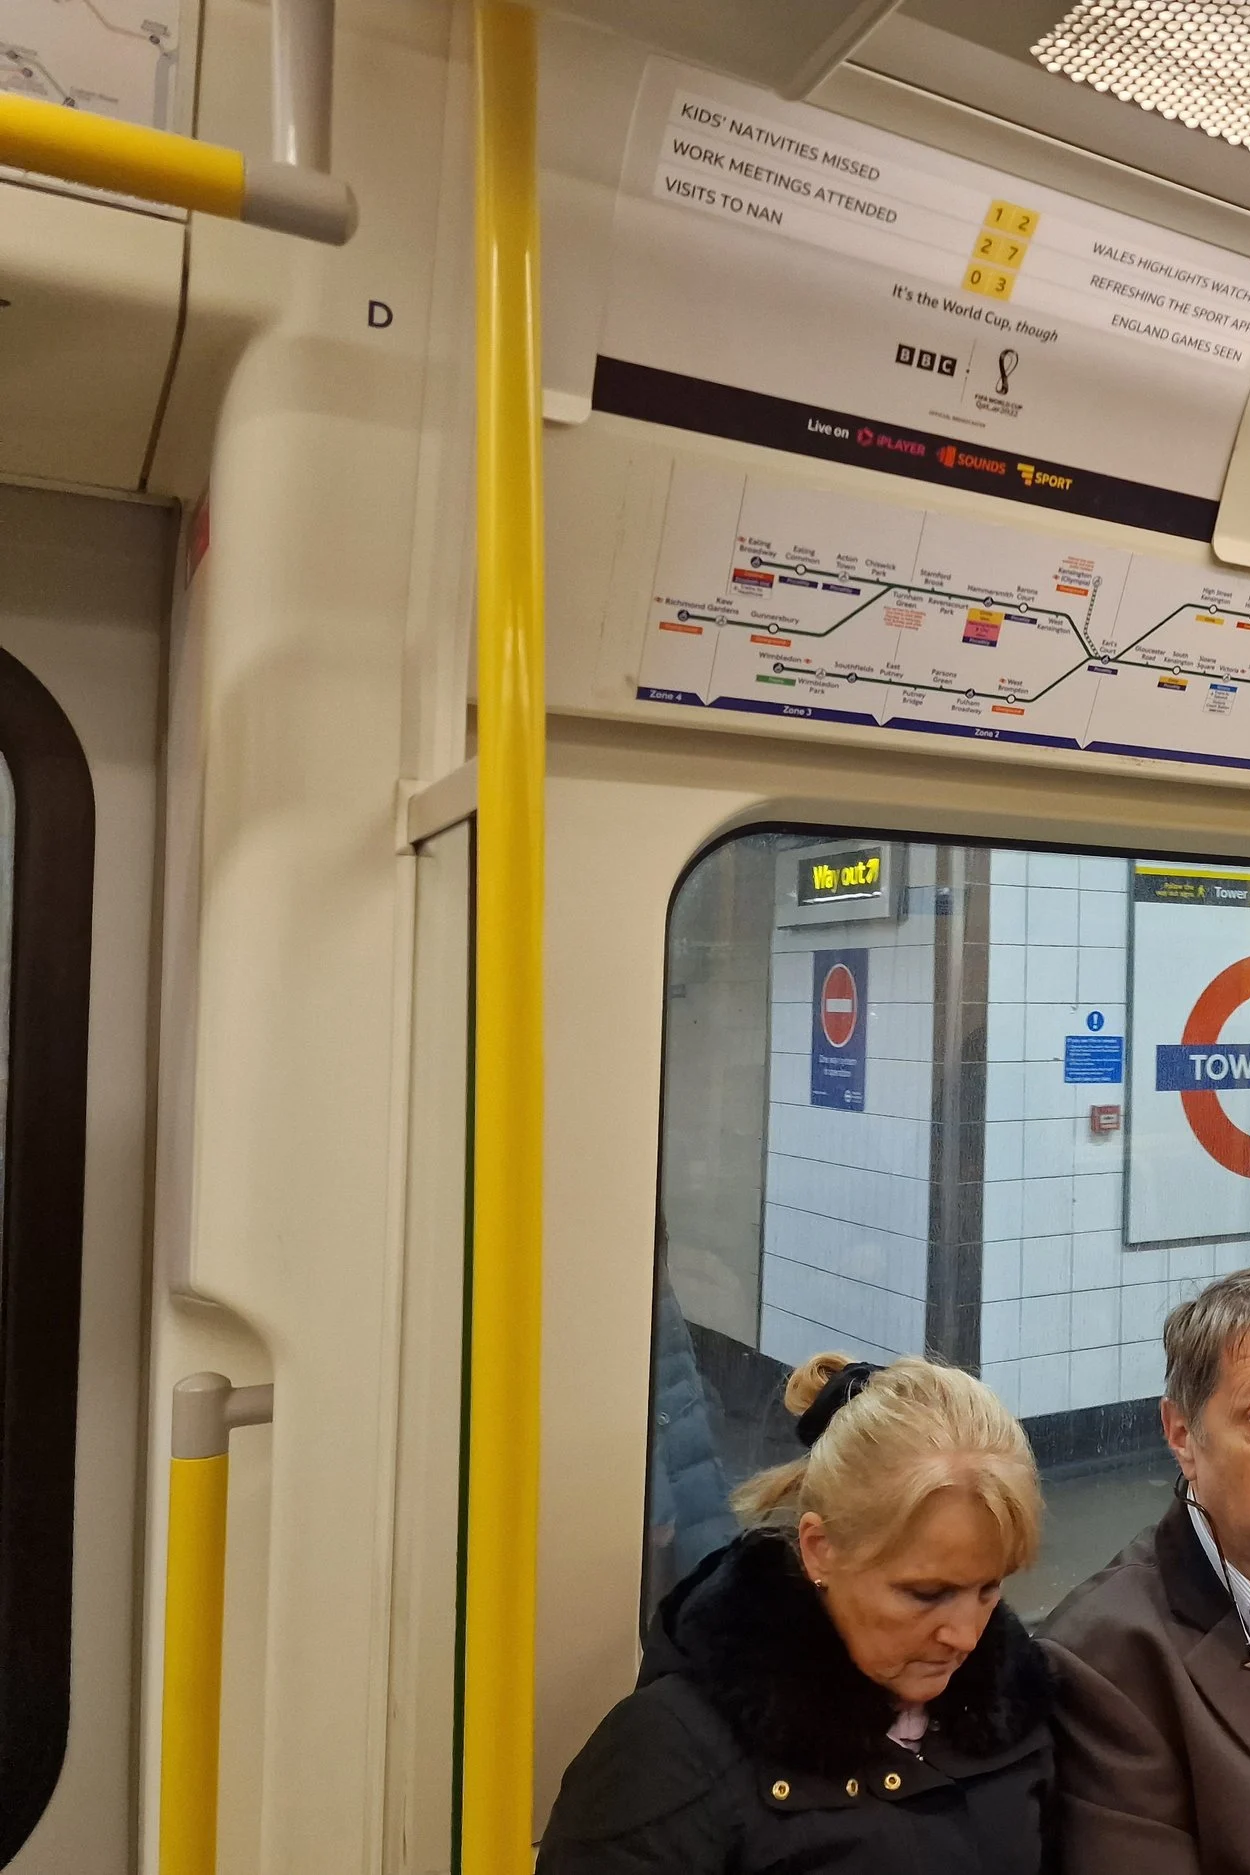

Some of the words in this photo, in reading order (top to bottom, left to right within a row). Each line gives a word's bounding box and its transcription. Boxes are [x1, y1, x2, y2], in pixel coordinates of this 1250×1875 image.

[681, 102, 727, 128] KIDS'
[729, 119, 818, 161] NATIVITIES
[822, 151, 880, 181] MISSED
[995, 208, 1003, 222] 1
[1018, 216, 1030, 232] 2
[1093, 242, 1135, 265] WALES
[1137, 257, 1209, 288] HIGHLIGHTS
[673, 139, 725, 168] WORK
[729, 158, 812, 196] MEETINGS
[814, 187, 898, 224] ATTENDED
[980, 238, 992, 254] 2
[1008, 247, 1019, 261] 7
[1090, 274, 1165, 308] REFRESHING
[1168, 298, 1191, 315] THE
[1193, 306, 1231, 326] SPORT
[665, 176, 716, 204] VISITS
[720, 193, 743, 213] TO
[747, 203, 783, 225] NAN
[971, 270, 982, 285] 0
[995, 277, 1006, 292] 3
[1111, 314, 1169, 340] ENGLAND
[1171, 332, 1211, 353] GAMES
[1212, 344, 1242, 362] SEEN
[368, 300, 393, 328] D
[892, 283, 914, 301] It's
[917, 292, 939, 308] the
[943, 298, 983, 321] World
[985, 311, 1012, 332] Cup,
[1015, 321, 1058, 343] though
[896, 344, 957, 376] BBC
[807, 418, 832, 436] Live
[834, 425, 849, 439] on
[876, 436, 926, 456] iPLAYER
[958, 453, 1006, 474] SOUNDS
[1035, 471, 1072, 491] SPORT
[967, 585, 1014, 598] Hammersmith
[751, 610, 800, 625] Gunnersbury
[758, 651, 802, 663] Wimbledon
[650, 690, 675, 701] Zone
[675, 691, 682, 701] 4
[782, 705, 805, 716] Zone
[806, 708, 812, 717] 3
[974, 728, 993, 738] Zone
[813, 864, 840, 893] Way
[841, 861, 866, 886] out
[1214, 886, 1248, 900] Tower
